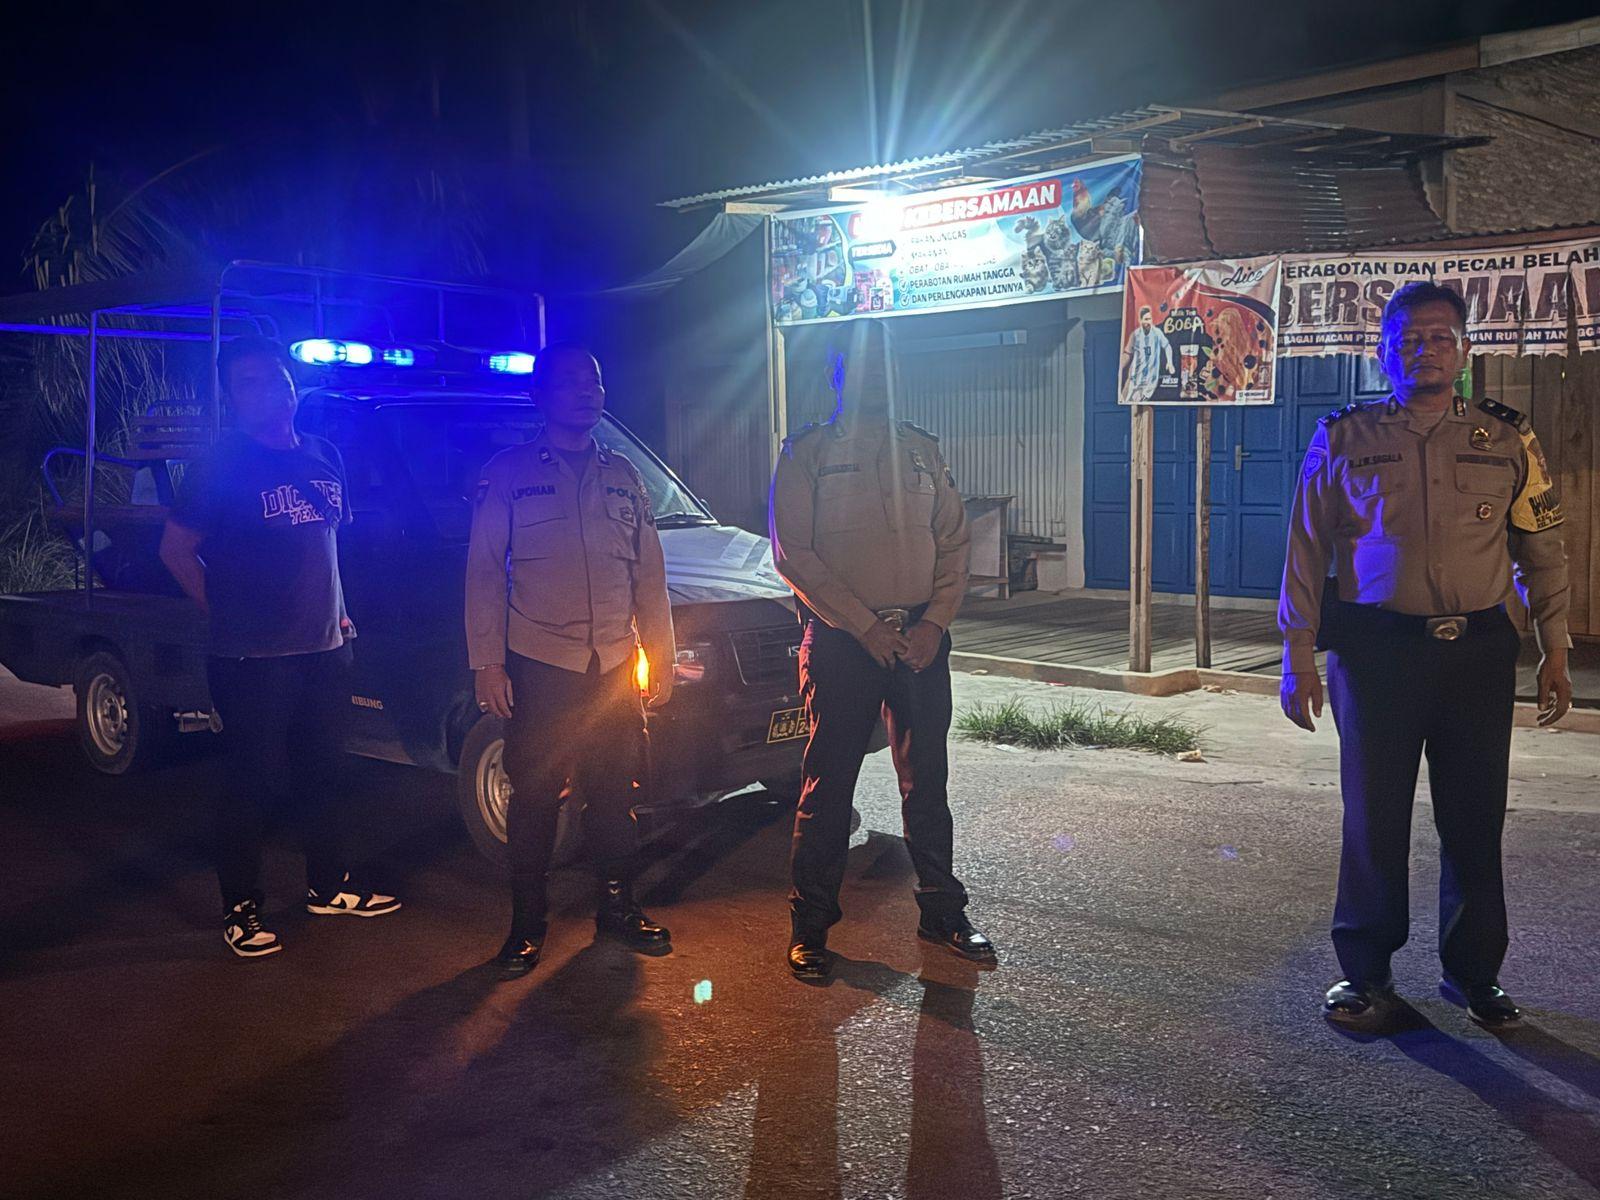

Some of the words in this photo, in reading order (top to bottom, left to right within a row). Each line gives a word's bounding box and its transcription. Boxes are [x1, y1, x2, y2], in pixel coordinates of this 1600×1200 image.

[1281, 261, 1388, 279] ERABOTAN
[1393, 261, 1437, 275] DAN
[1443, 256, 1516, 273] PECAH
[1522, 247, 1599, 269] BELAH
[910, 274, 951, 289] PERABOTAN
[953, 271, 981, 285] RUMAH
[983, 267, 1016, 281] TANGGA
[1221, 266, 1264, 287] Aice
[911, 293, 927, 304] DAN
[928, 286, 987, 302] PERLENGKAPAN
[988, 282, 1024, 295] LAINNYA
[1164, 315, 1204, 335] BOBA
[1315, 333, 1351, 344] MACAM
